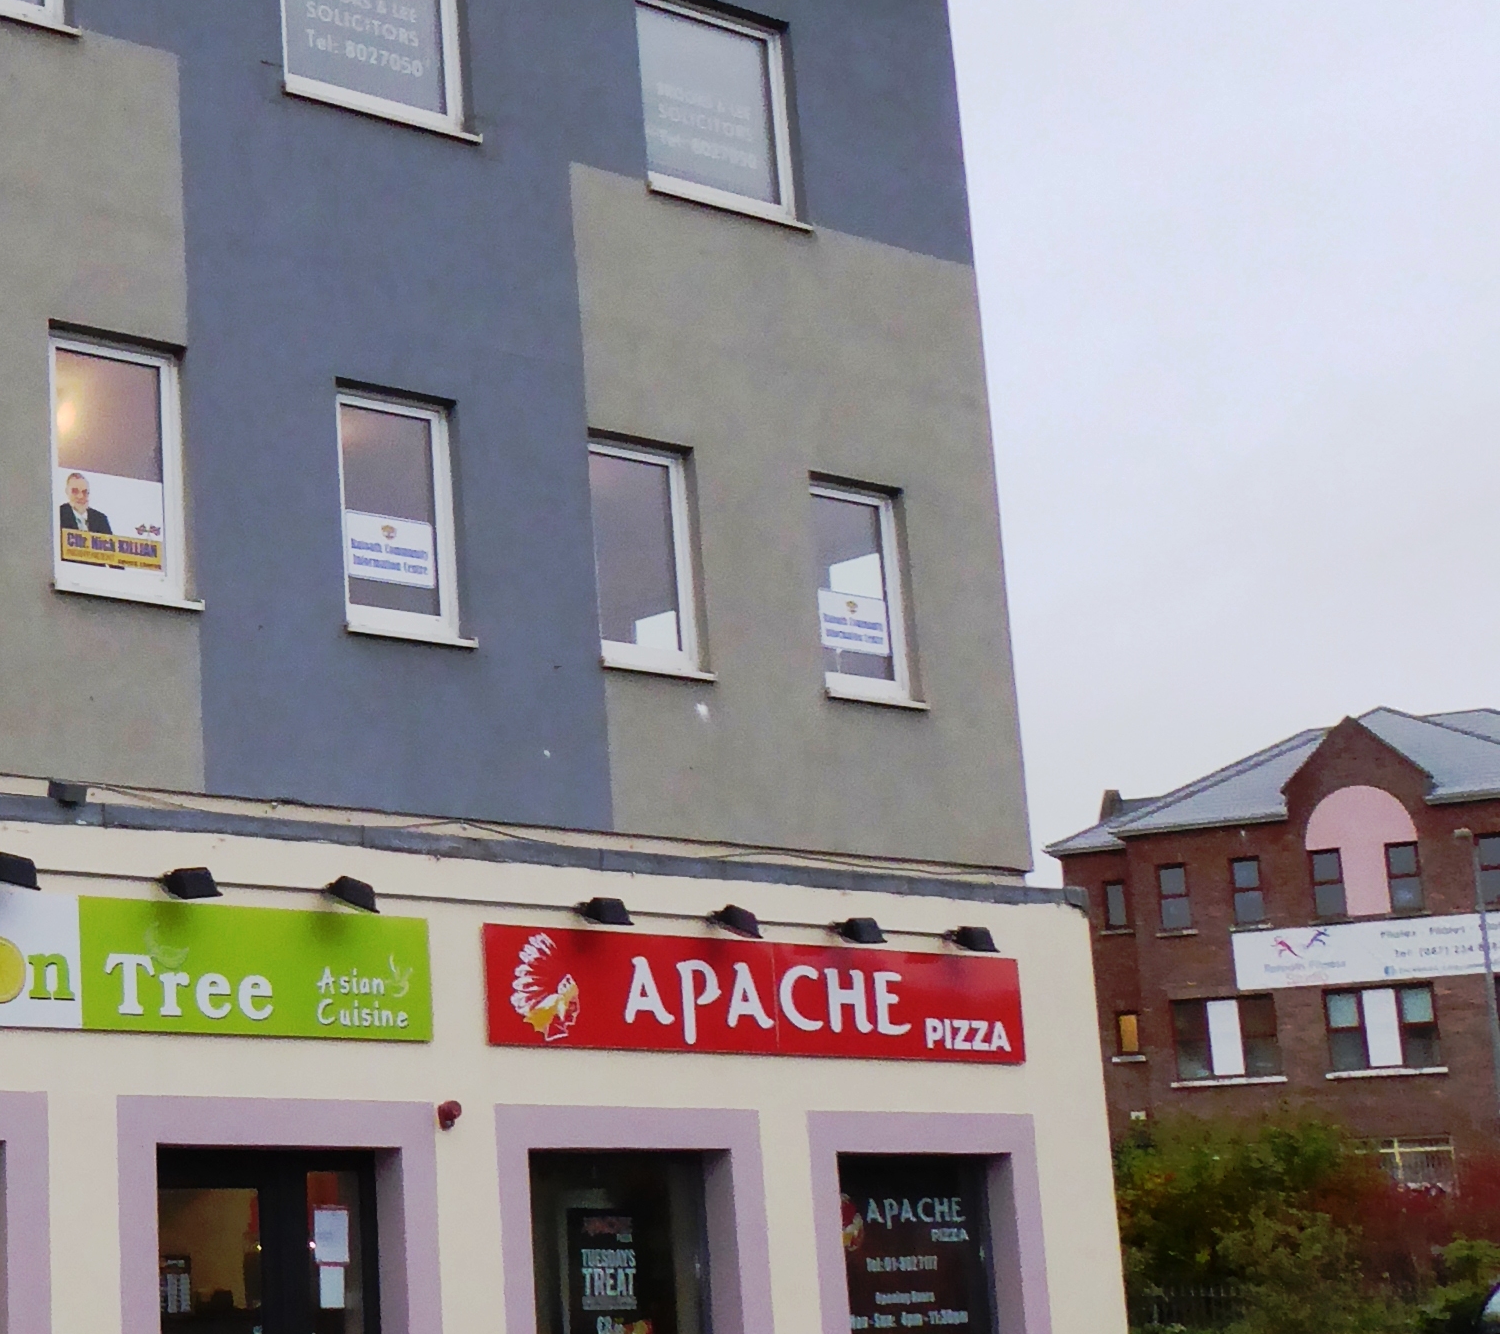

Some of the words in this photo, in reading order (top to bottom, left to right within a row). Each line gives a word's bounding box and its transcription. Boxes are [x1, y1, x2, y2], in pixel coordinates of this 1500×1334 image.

[305, 0, 419, 47] SOLICITORS
[105, 953, 274, 1021] Tree
[317, 967, 386, 996] Asian
[317, 998, 409, 1028] Cuisine
[625, 956, 911, 1045] APACHE
[925, 1018, 1012, 1053] PIZZA
[866, 1197, 967, 1230] APACHE
[582, 1268, 637, 1296] TREAT
